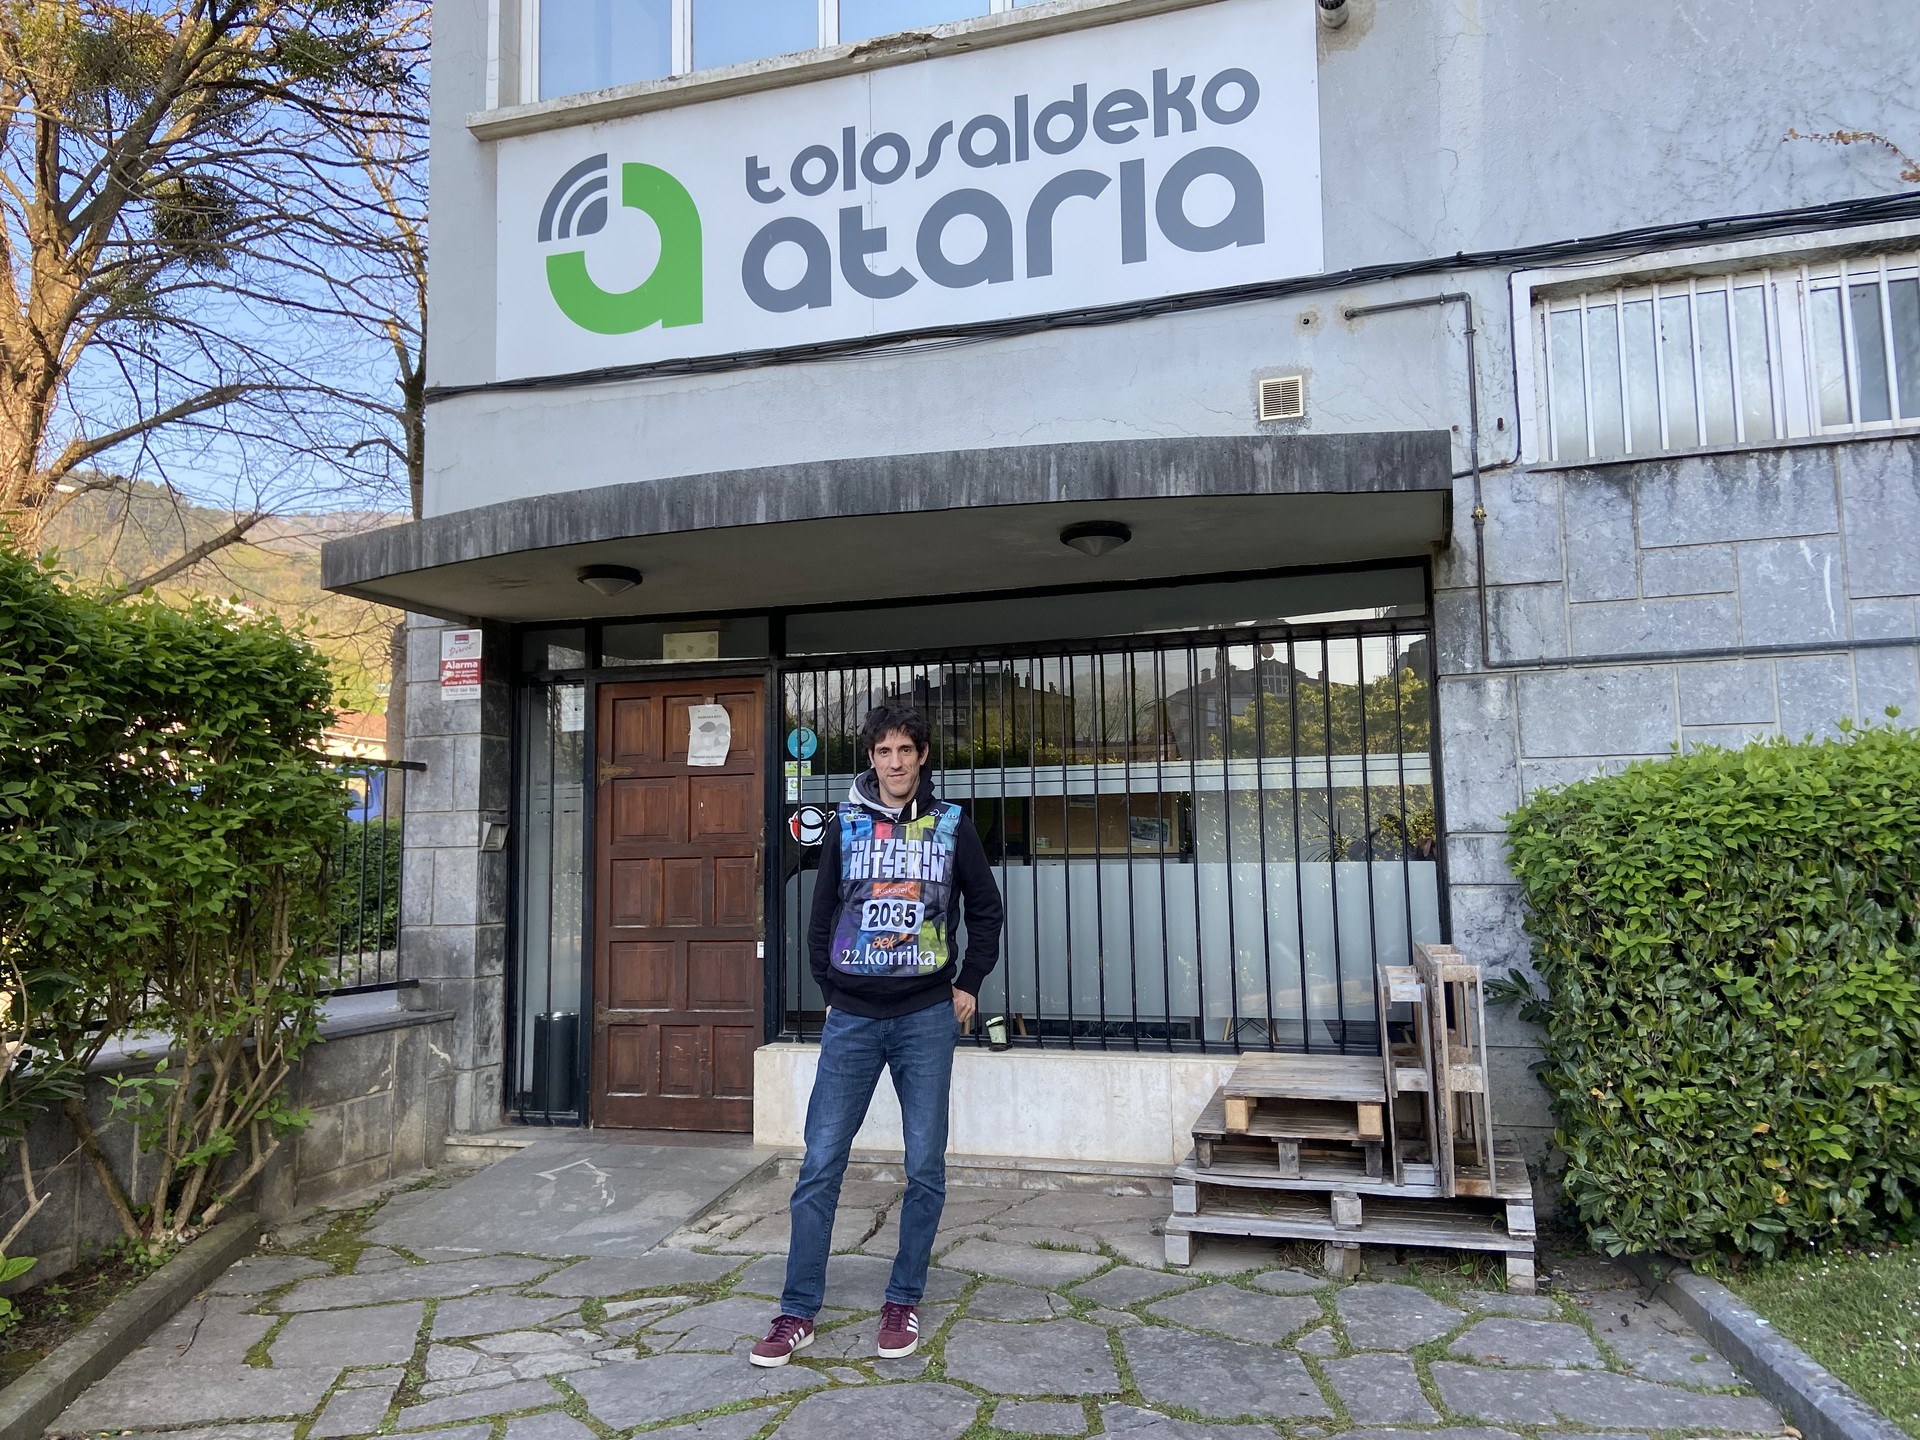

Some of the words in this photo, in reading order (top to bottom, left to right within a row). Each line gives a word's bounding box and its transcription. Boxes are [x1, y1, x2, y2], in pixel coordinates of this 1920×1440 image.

[745, 67, 1261, 205] tolosaldeko
[741, 146, 1265, 314] ataria
[445, 661, 478, 669] Alarma
[868, 903, 917, 928] 2035
[872, 934, 897, 950] aek
